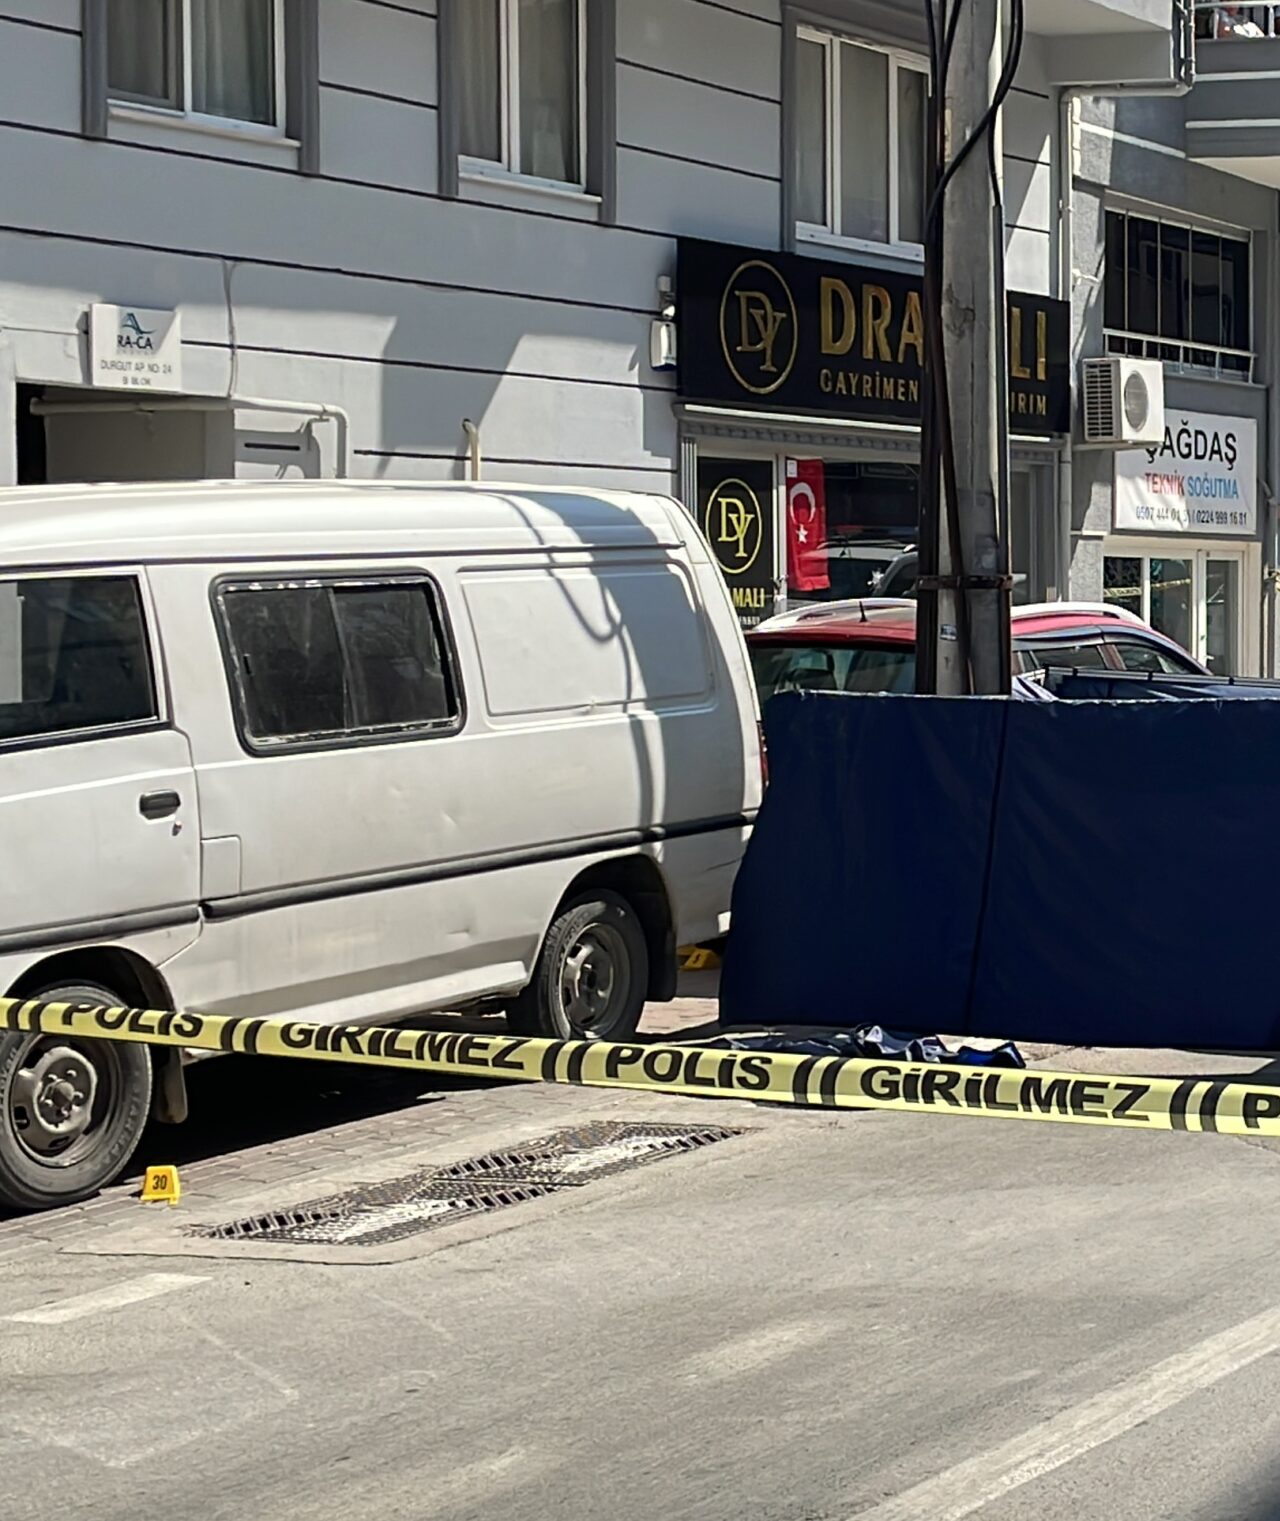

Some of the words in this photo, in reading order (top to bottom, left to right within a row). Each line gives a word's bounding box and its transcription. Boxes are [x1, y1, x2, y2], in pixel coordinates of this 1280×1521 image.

[820, 276, 1046, 381] DRALI
[1144, 469, 1186, 497] TEKNİK
[1187, 472, 1240, 499] SOĞUTMA
[1196, 510, 1214, 523] 0224
[605, 1046, 772, 1092] POLİS
[859, 1065, 1150, 1122] GİRİLMEZ
[152, 1174, 168, 1190] 30
